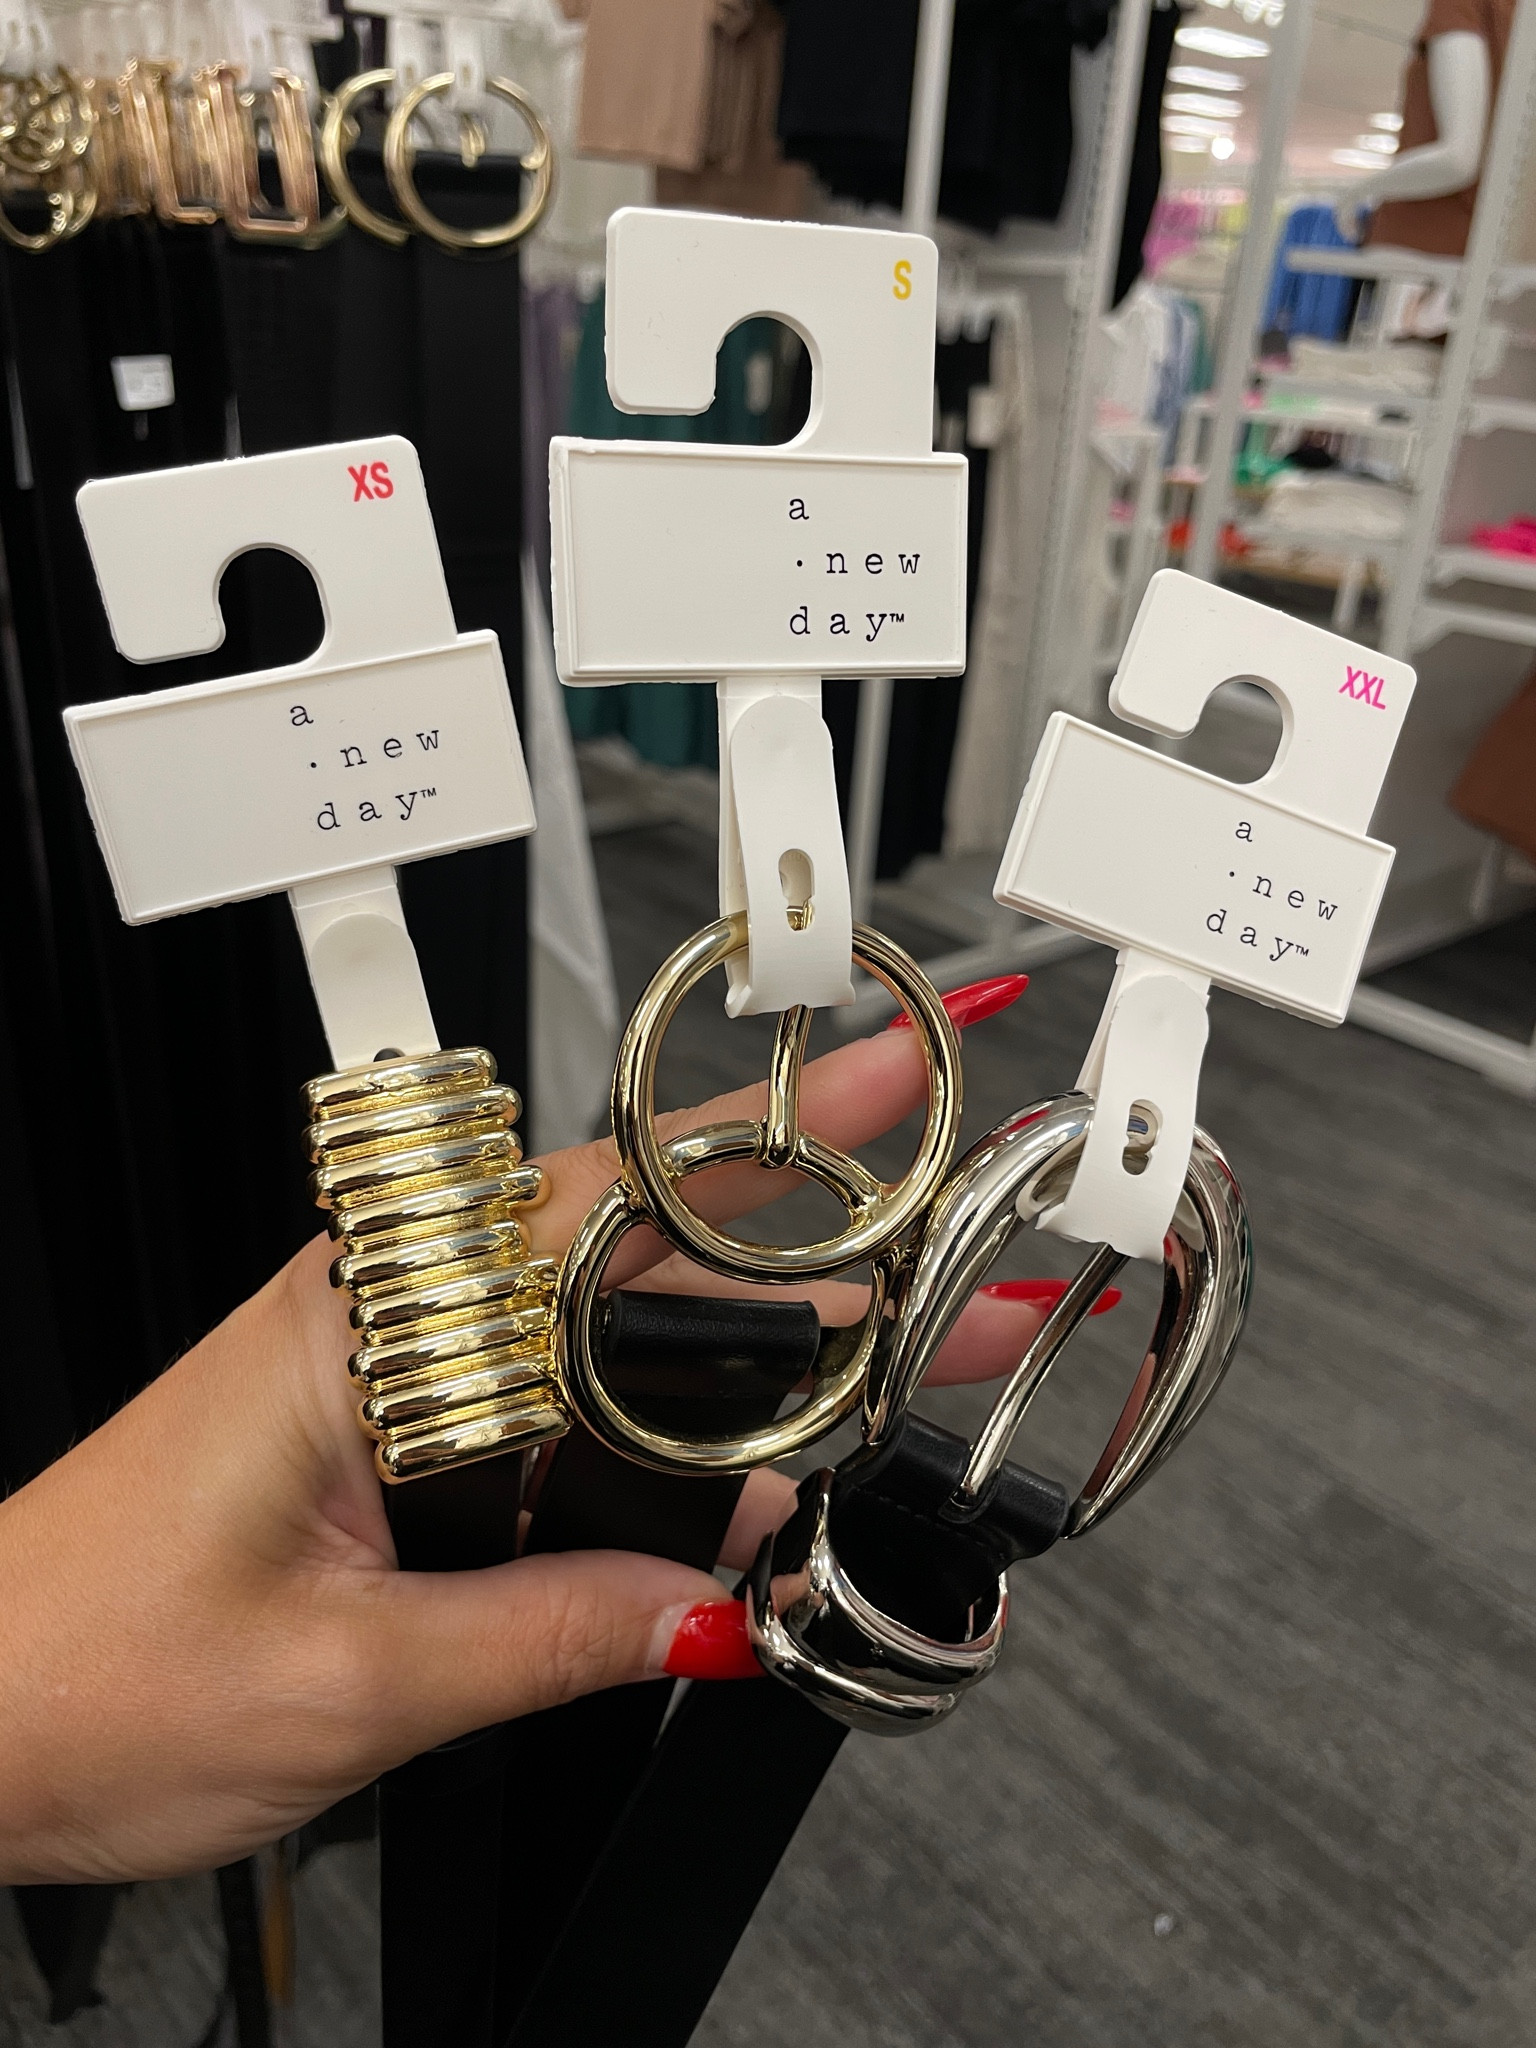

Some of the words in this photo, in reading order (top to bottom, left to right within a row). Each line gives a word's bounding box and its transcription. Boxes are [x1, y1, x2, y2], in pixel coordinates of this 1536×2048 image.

[892, 259, 913, 301] S
[347, 461, 394, 502] XS
[788, 498, 810, 521] a
[1338, 665, 1386, 710] XXL
[289, 705, 315, 727] a
[1235, 821, 1253, 843] a
